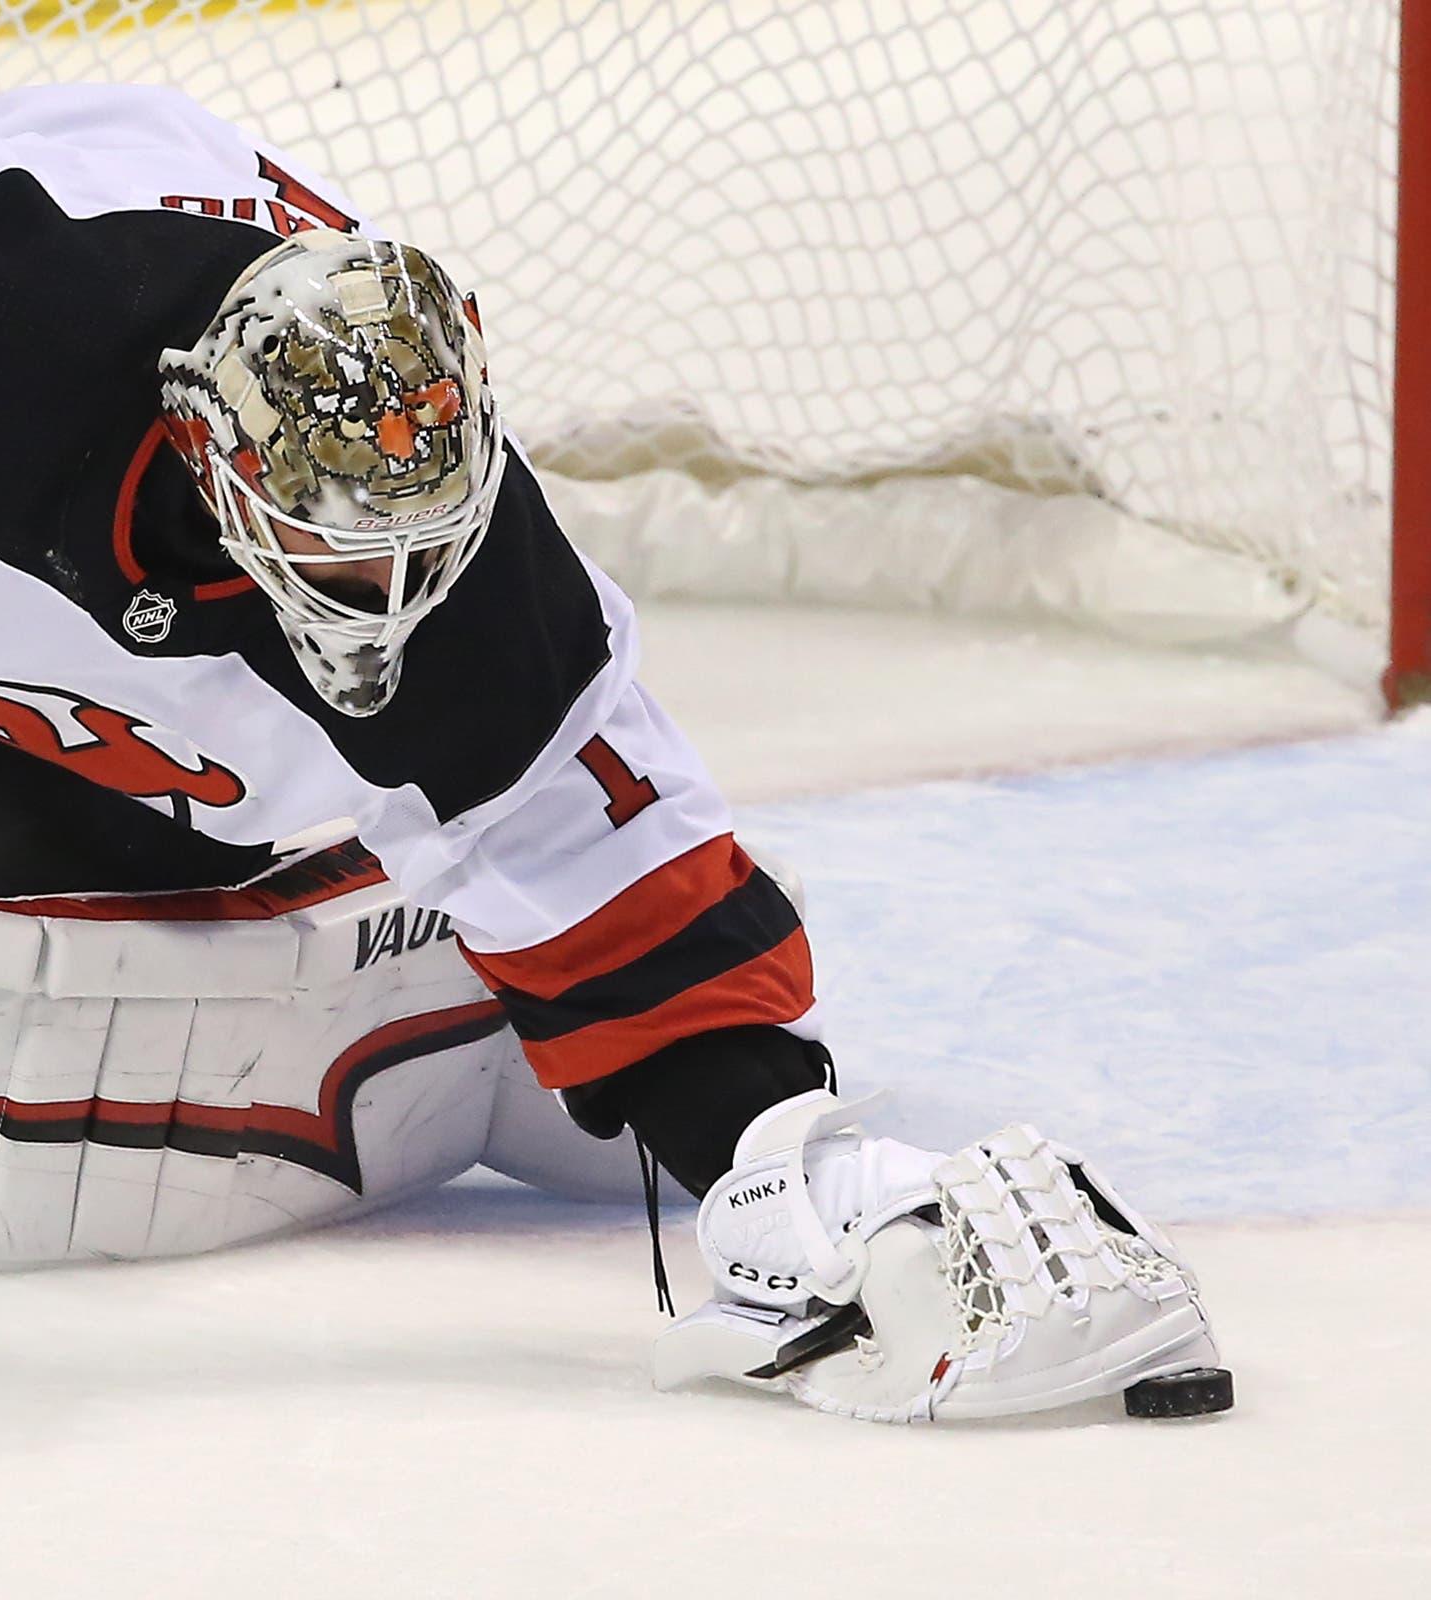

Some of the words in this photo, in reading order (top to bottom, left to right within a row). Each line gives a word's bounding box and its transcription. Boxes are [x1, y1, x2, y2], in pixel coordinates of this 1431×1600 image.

[353, 503, 449, 529] BAUER
[132, 609, 164, 626] NHL
[574, 732, 661, 831] 1
[728, 1173, 809, 1209] KINKA
